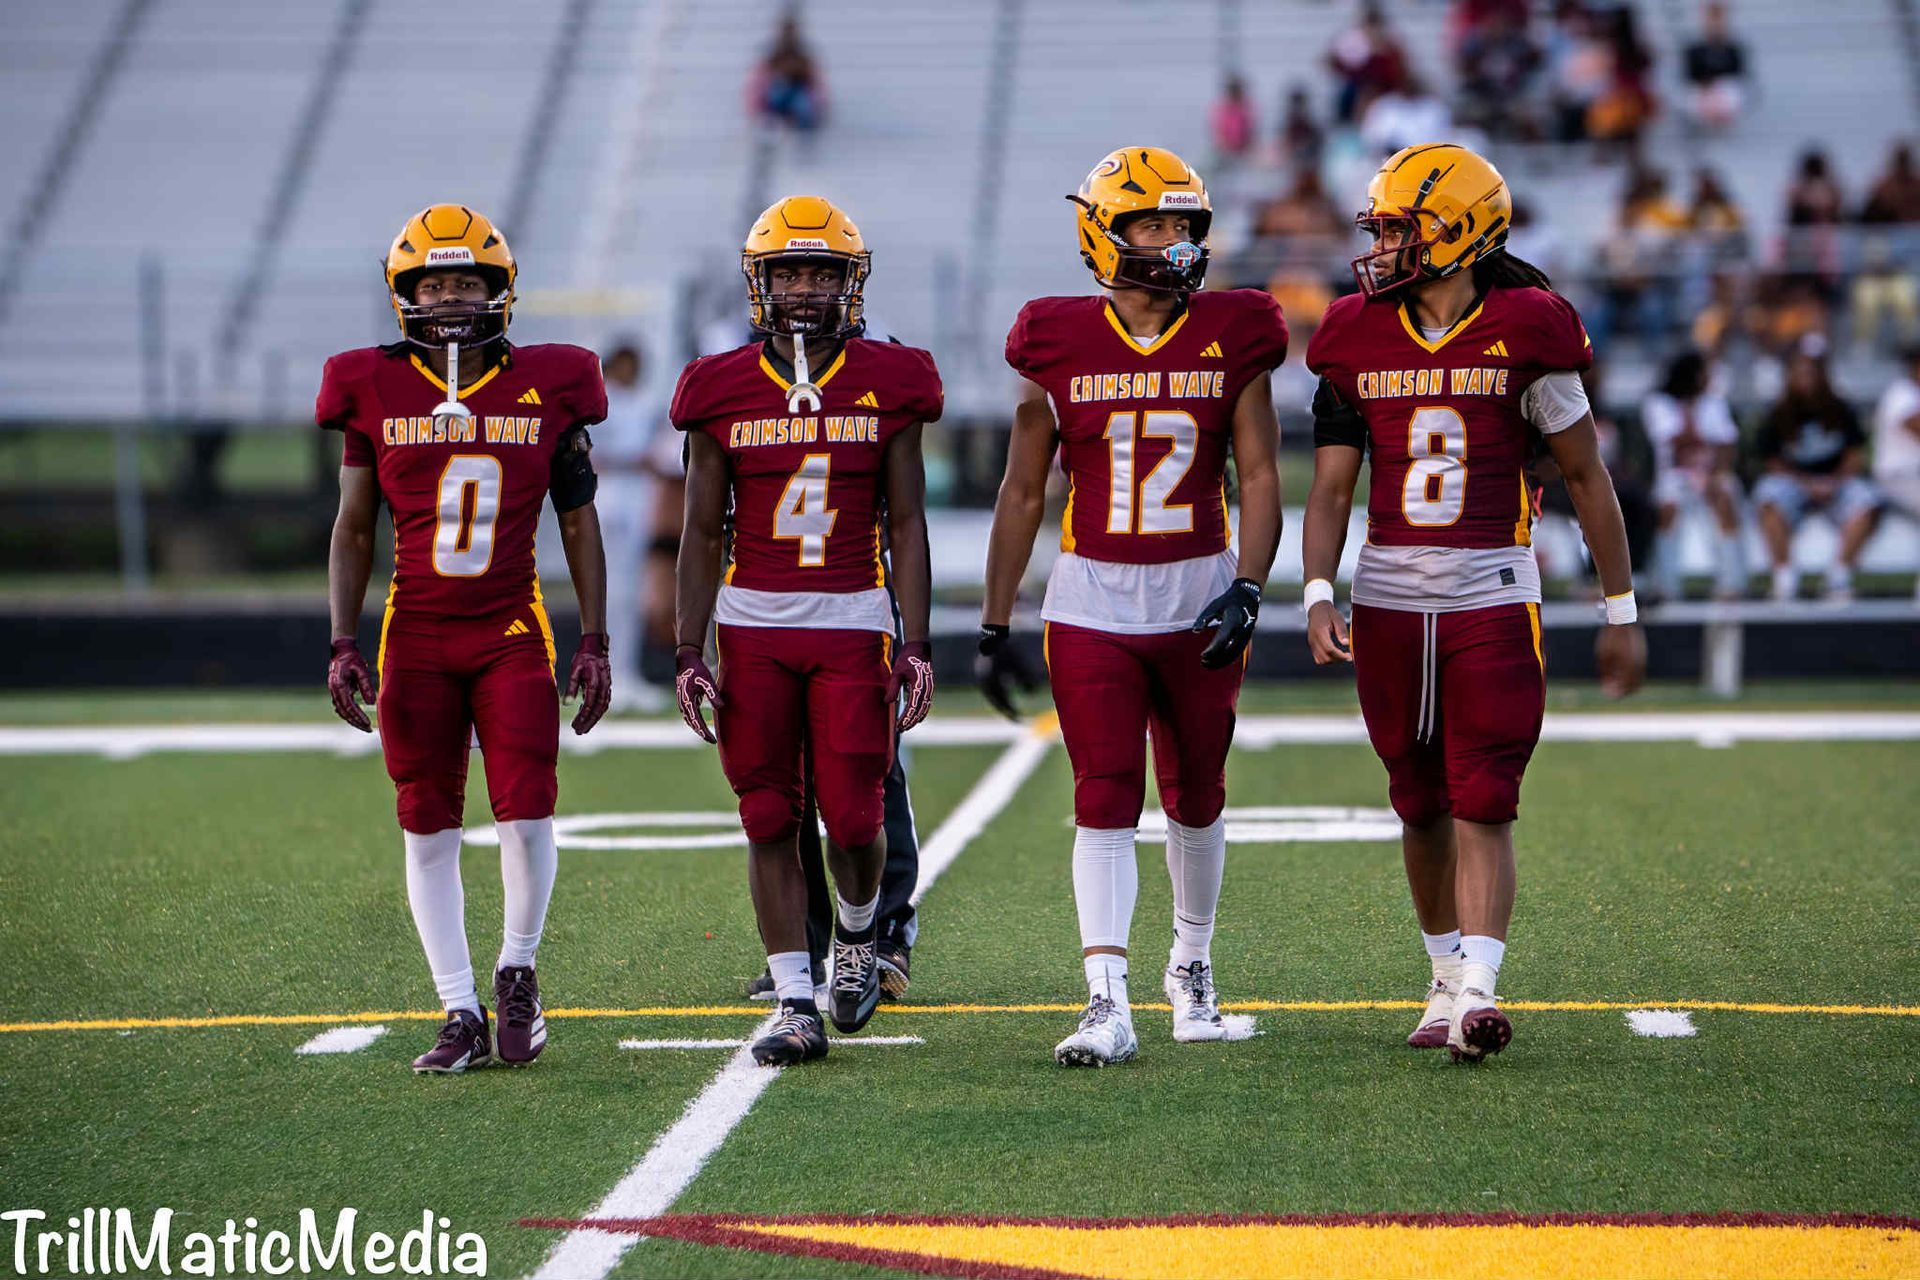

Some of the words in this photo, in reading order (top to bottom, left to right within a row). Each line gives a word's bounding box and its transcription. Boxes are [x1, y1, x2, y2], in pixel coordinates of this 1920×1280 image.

[1164, 195, 1199, 204] Riddell
[430, 251, 470, 261] Riddell
[1070, 371, 1162, 403] CRIMSON
[1168, 371, 1225, 398] WAVE
[1357, 368, 1444, 399] CRIMSON
[1451, 368, 1509, 395] WAVE
[484, 416, 542, 445] WAVE
[729, 416, 819, 448] CRIMSON
[825, 416, 879, 442] WAVE
[1103, 410, 1199, 535] 12
[1401, 406, 1468, 527] 8
[432, 454, 503, 577] 0
[773, 453, 838, 567] 4
